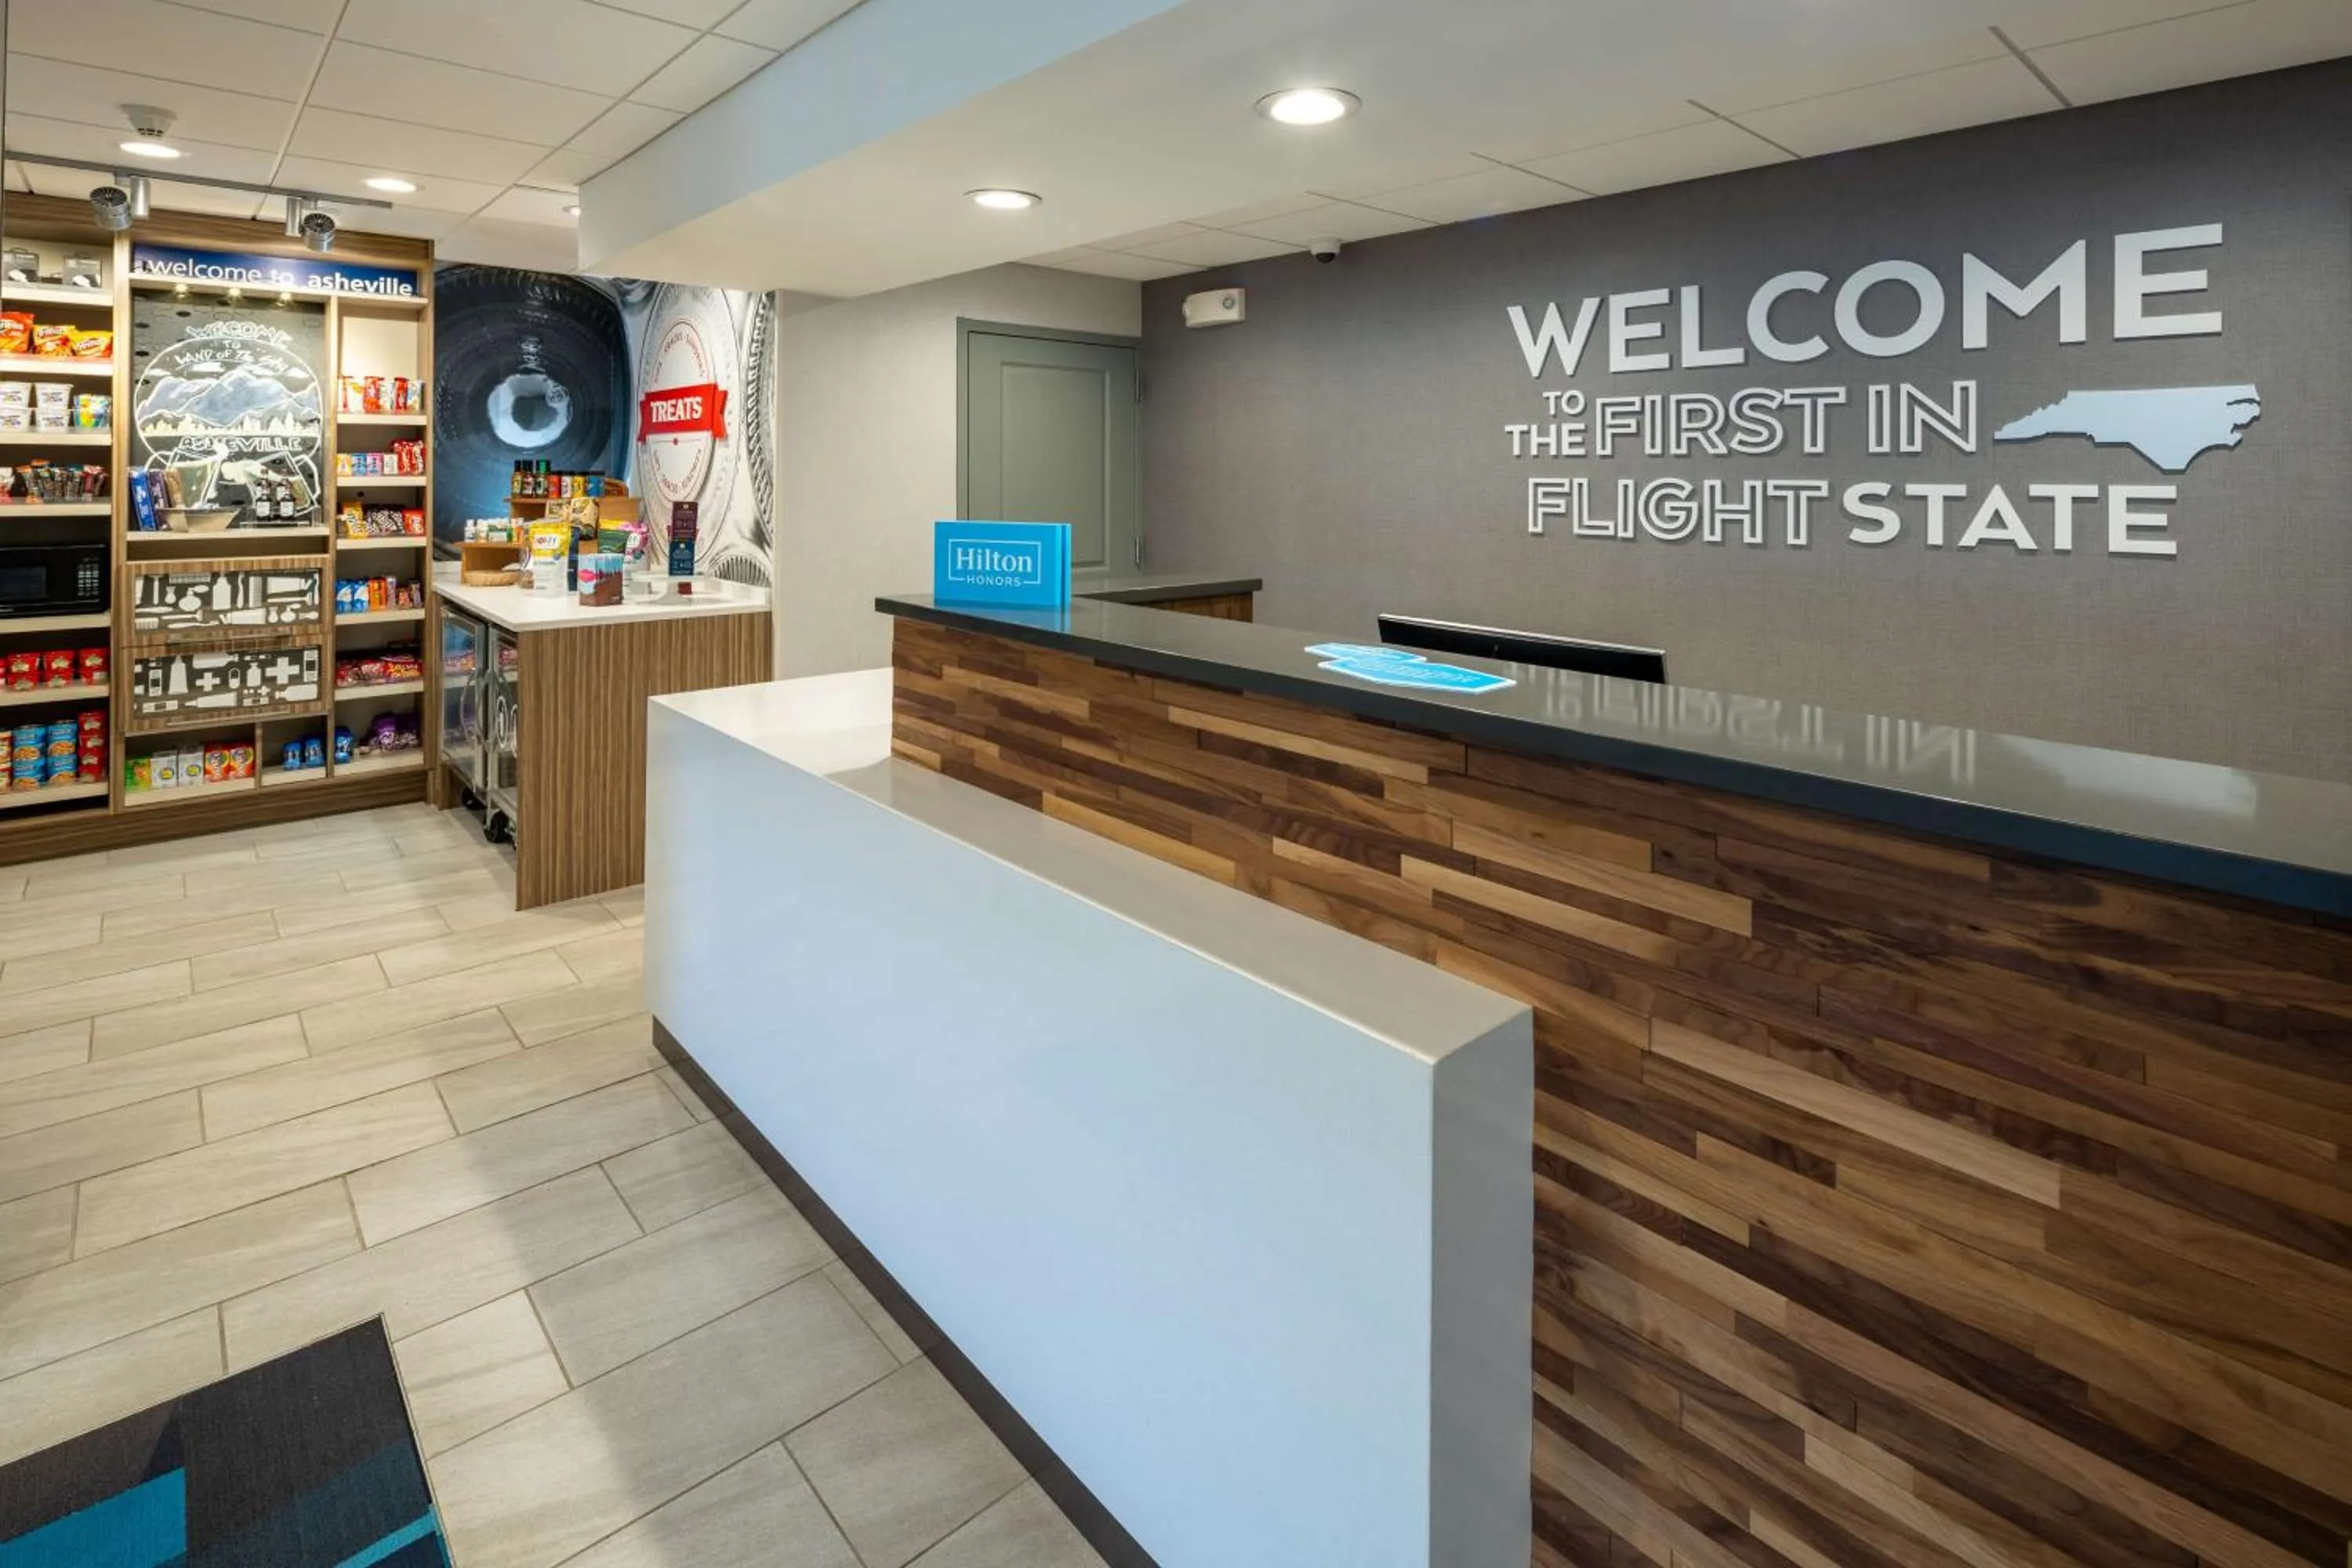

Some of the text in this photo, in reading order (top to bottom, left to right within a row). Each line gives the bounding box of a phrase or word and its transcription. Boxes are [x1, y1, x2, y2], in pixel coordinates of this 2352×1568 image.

[148, 258, 413, 296] welcome to asheville
[1507, 223, 2223, 378] WELCOME
[651, 396, 702, 423] TREATS
[1504, 380, 1976, 456] THE FIRST IN
[1542, 389, 1585, 416] TO
[1527, 477, 2177, 554] FLIGHT STATE
[955, 547, 1033, 573] Hilton
[967, 575, 1021, 587] HONORS
